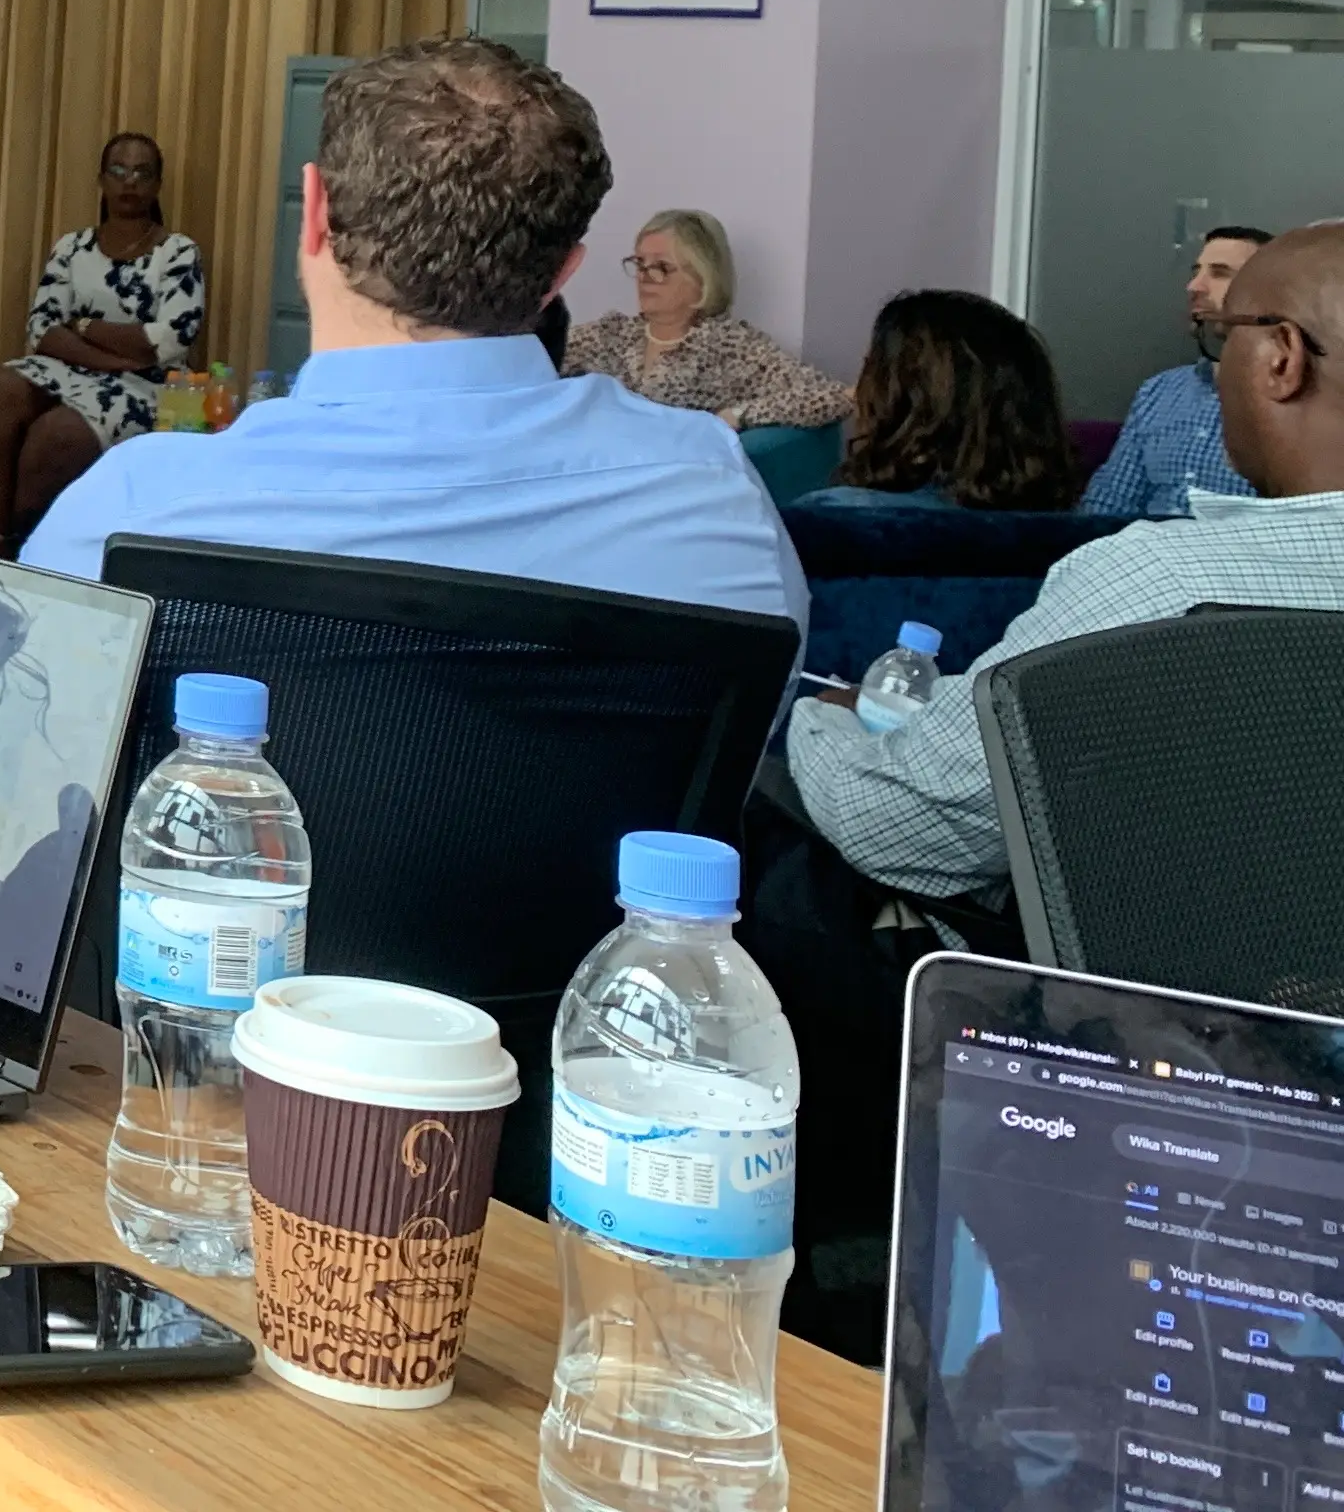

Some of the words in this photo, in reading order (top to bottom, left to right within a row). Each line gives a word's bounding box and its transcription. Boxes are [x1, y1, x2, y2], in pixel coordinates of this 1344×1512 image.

[980, 1031, 1007, 1045] Inbox
[1205, 1072, 1225, 1084] PPT
[1226, 1076, 1264, 1093] generic
[1273, 1085, 1292, 1098] Feb
[1000, 1106, 1077, 1140] Google
[744, 1141, 794, 1180] INYA
[1129, 1134, 1160, 1152] Wika
[1163, 1140, 1220, 1164] Translate
[1144, 1184, 1159, 1197] All
[1125, 1215, 1159, 1231] About
[1263, 1208, 1304, 1227] Images
[279, 1213, 391, 1260] RISTRETTO
[292, 1242, 360, 1293] Coffee
[281, 1269, 366, 1322] Break
[1169, 1263, 1205, 1285] Your
[1207, 1272, 1275, 1300] business
[1278, 1289, 1299, 1304] on
[1302, 1292, 1344, 1318] Goog
[287, 1306, 402, 1351] ESPRESSO
[1135, 1328, 1157, 1344] Edit
[1158, 1335, 1195, 1352] profile
[1221, 1347, 1251, 1364] Read
[1252, 1354, 1295, 1373] reviews
[1125, 1388, 1147, 1404] Edit
[1148, 1395, 1199, 1416] products
[1220, 1410, 1243, 1425] Edit
[1243, 1417, 1291, 1436] services
[1126, 1442, 1148, 1458] Set
[1150, 1450, 1168, 1465] up
[1169, 1453, 1222, 1478] booking
[1302, 1481, 1331, 1499] Add
